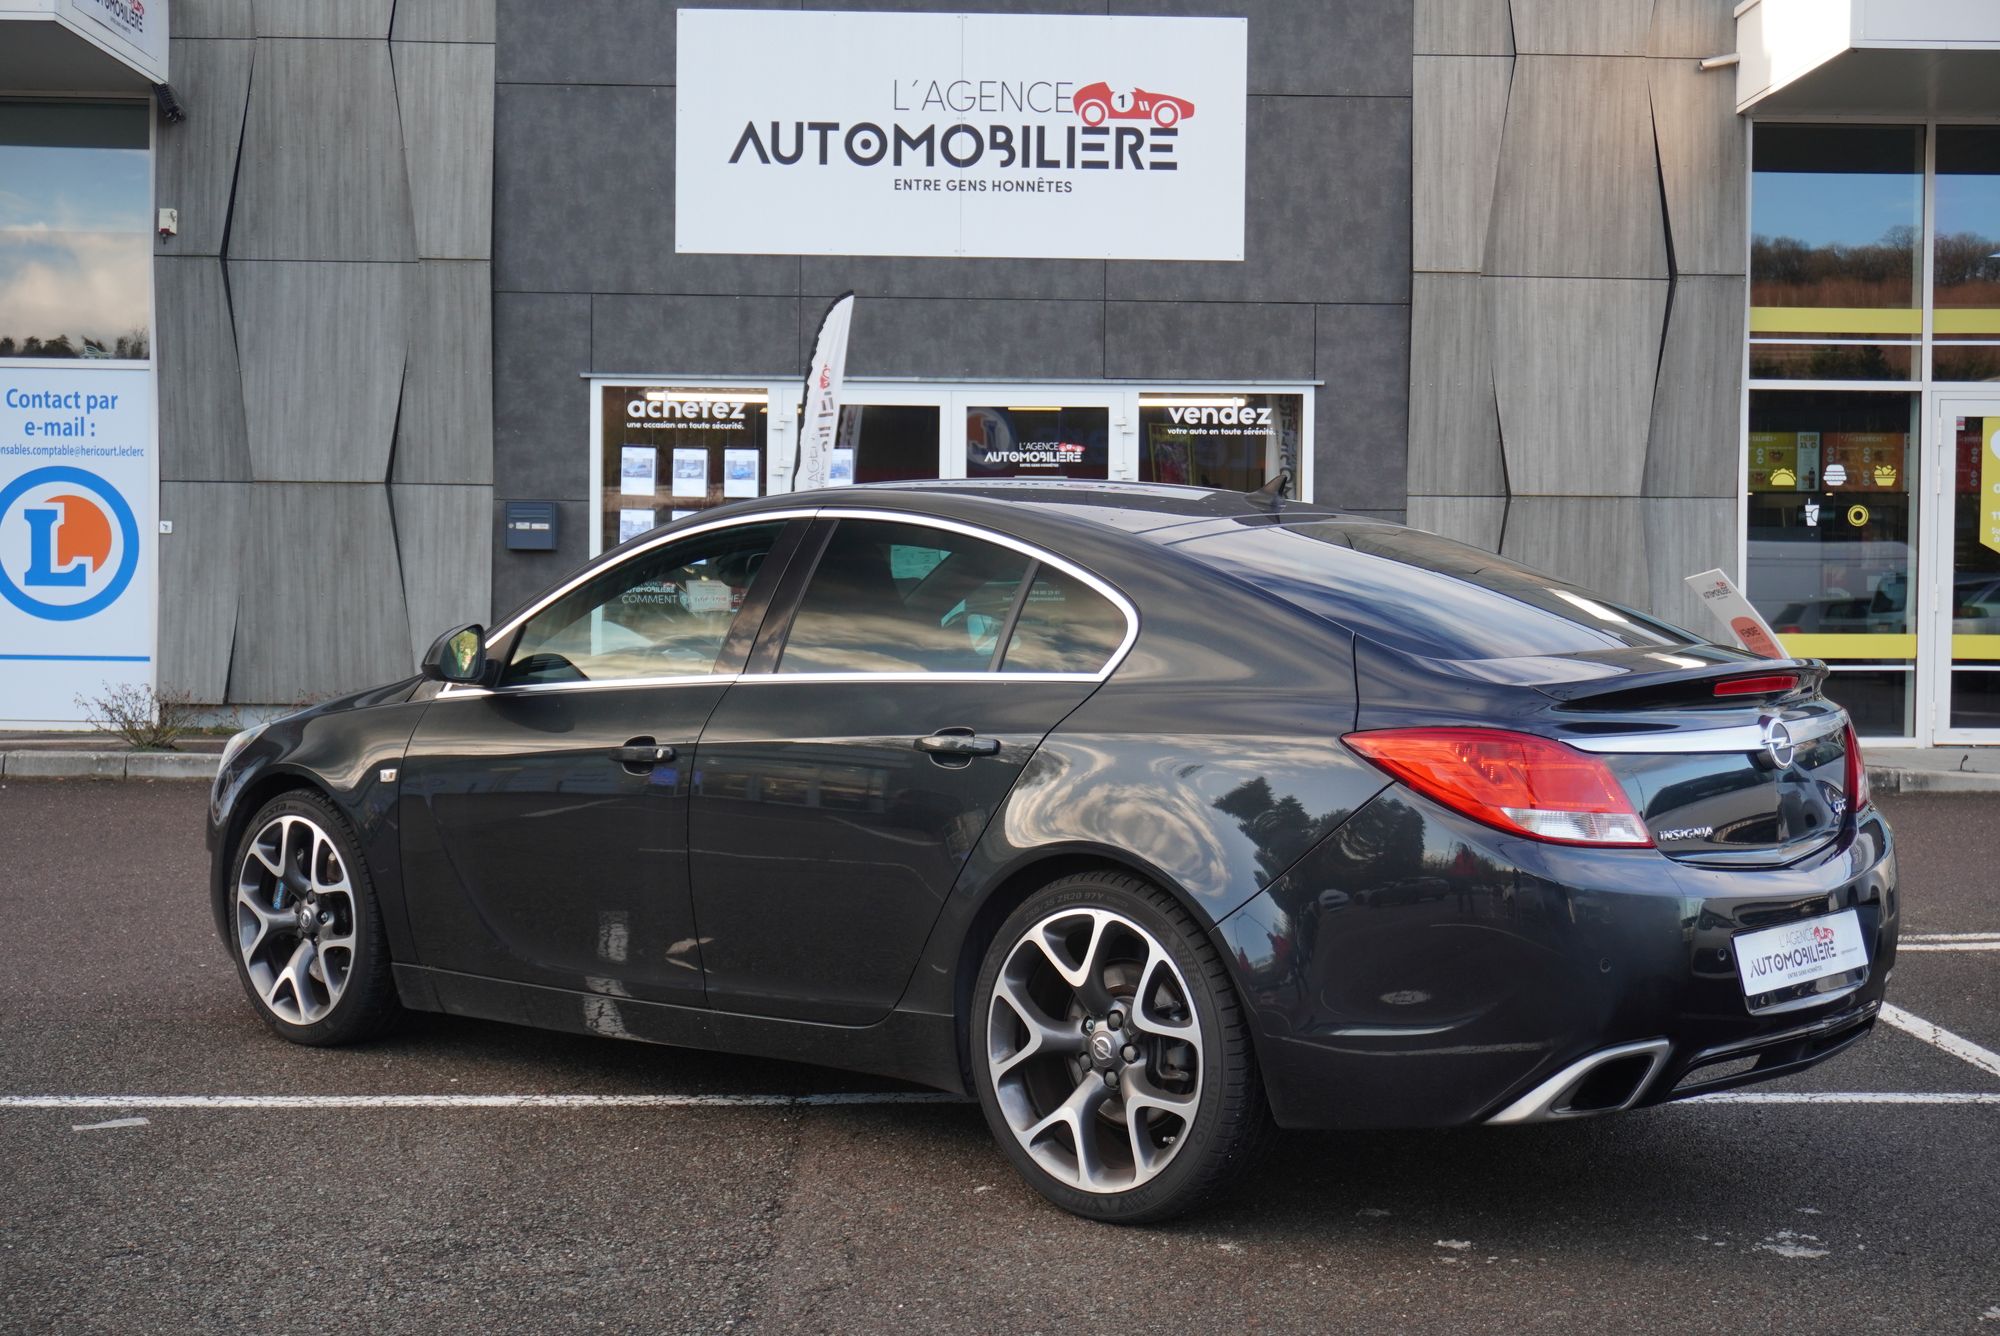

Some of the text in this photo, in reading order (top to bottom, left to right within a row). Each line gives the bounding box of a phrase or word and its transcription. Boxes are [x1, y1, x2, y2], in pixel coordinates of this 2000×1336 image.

[893, 79, 1074, 114] L'AGENCE
[894, 177, 1073, 193] ENTRE GENS HONNÊTES
[6, 388, 118, 414] Contact par
[627, 390, 746, 419] achetez
[1168, 397, 1272, 425] vendez
[24, 416, 85, 437] e-mail
[643, 421, 675, 429] occasion
[689, 421, 710, 430] toute
[1168, 427, 1187, 435] votre
[1189, 427, 1207, 435] auto
[1221, 427, 1241, 435] toute
[0, 443, 145, 458] nsables.comptable@hericourt.leclerc
[1019, 442, 1059, 451] L'AGENCE
[621, 594, 677, 604] COMMENT
[1658, 826, 1713, 840] INSIGNIA
